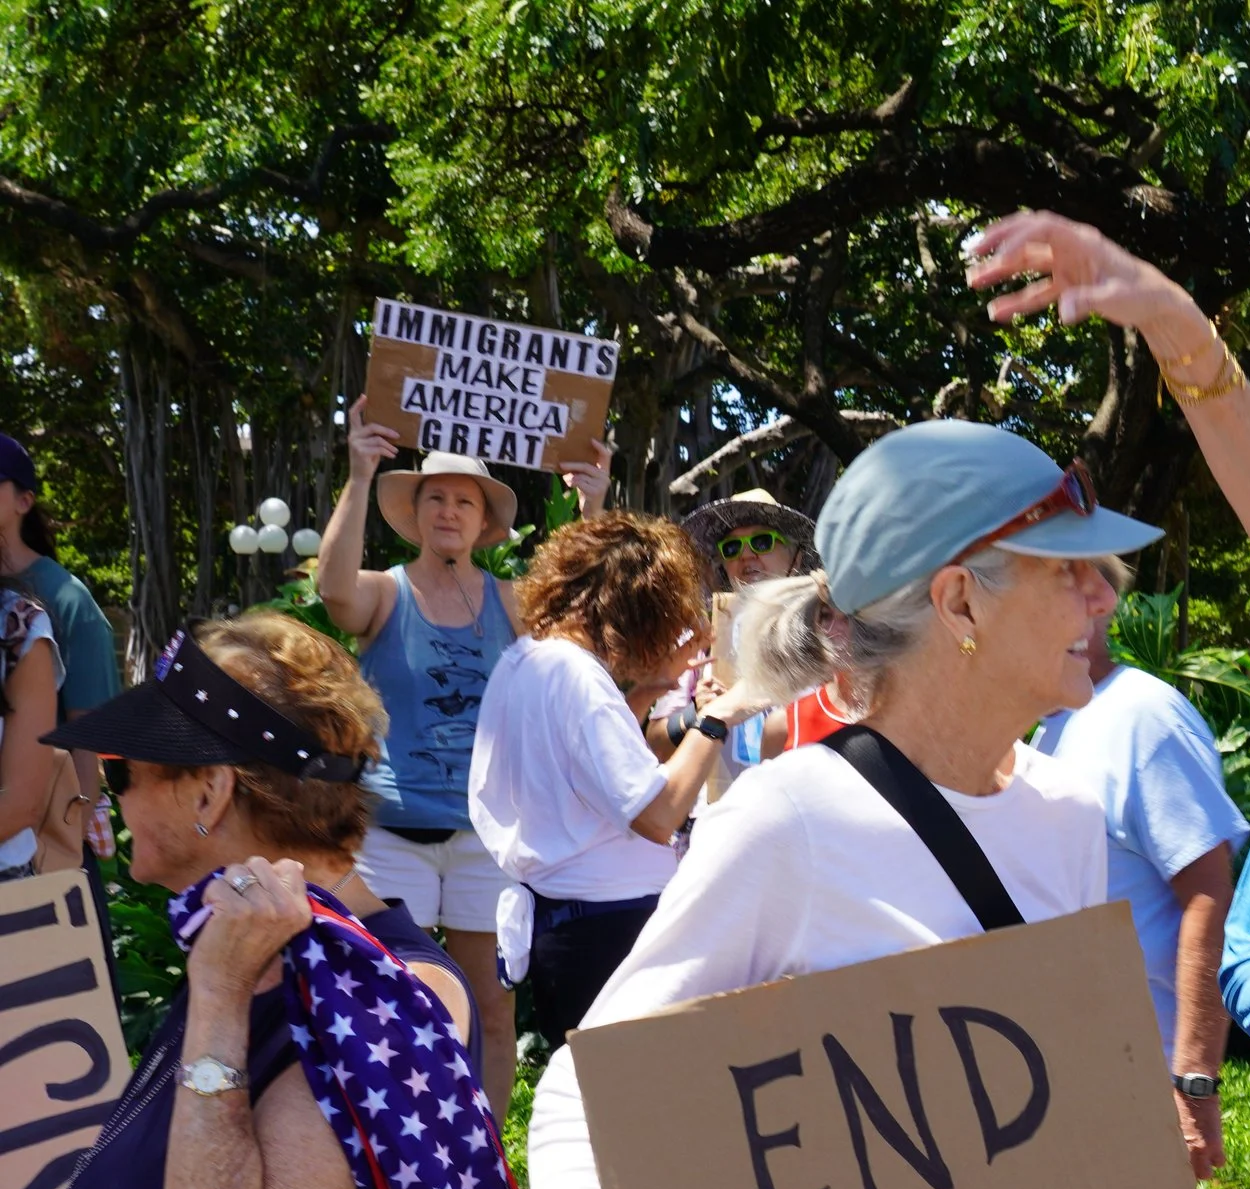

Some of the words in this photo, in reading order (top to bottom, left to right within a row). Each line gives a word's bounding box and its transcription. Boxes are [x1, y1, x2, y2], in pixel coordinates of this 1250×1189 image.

[380, 304, 615, 376] IMMIGRANTS
[439, 352, 541, 396] MAKE
[404, 382, 563, 434] AMERICA
[421, 418, 541, 465] GREAT
